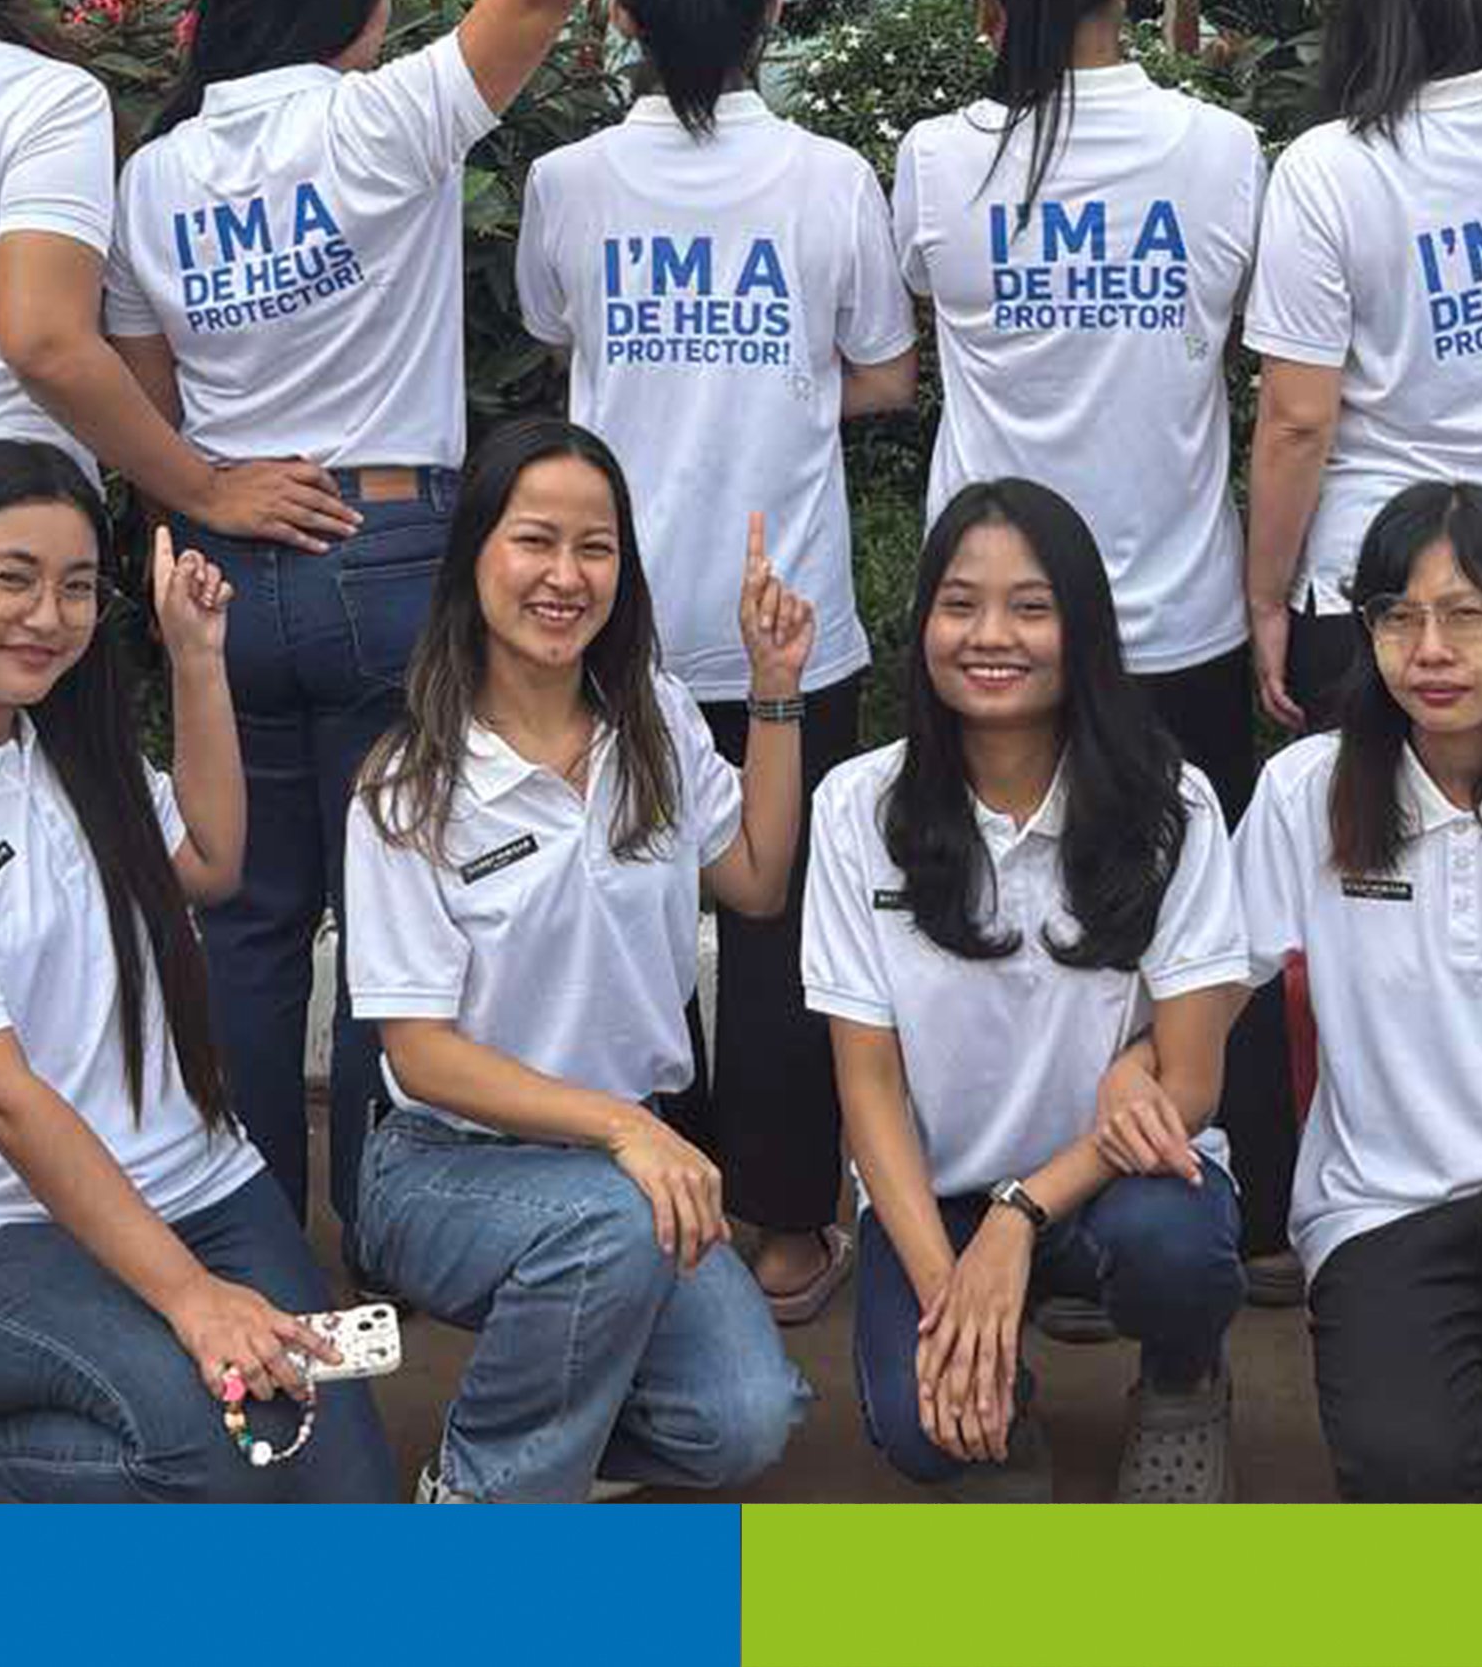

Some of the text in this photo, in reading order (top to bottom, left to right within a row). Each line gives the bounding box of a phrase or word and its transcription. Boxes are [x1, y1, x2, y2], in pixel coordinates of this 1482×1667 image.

[174, 183, 341, 270] I'M A
[1131, 200, 1187, 262] A
[183, 238, 355, 308] DE HEUS
[187, 260, 364, 333] PROTECTOR!
[603, 237, 789, 298] I'M A
[993, 265, 1187, 301] DE HEUS
[607, 300, 790, 338] DE HEUS
[995, 304, 1185, 330] PROTECTOR!
[607, 338, 790, 365] PROTECTOR!
